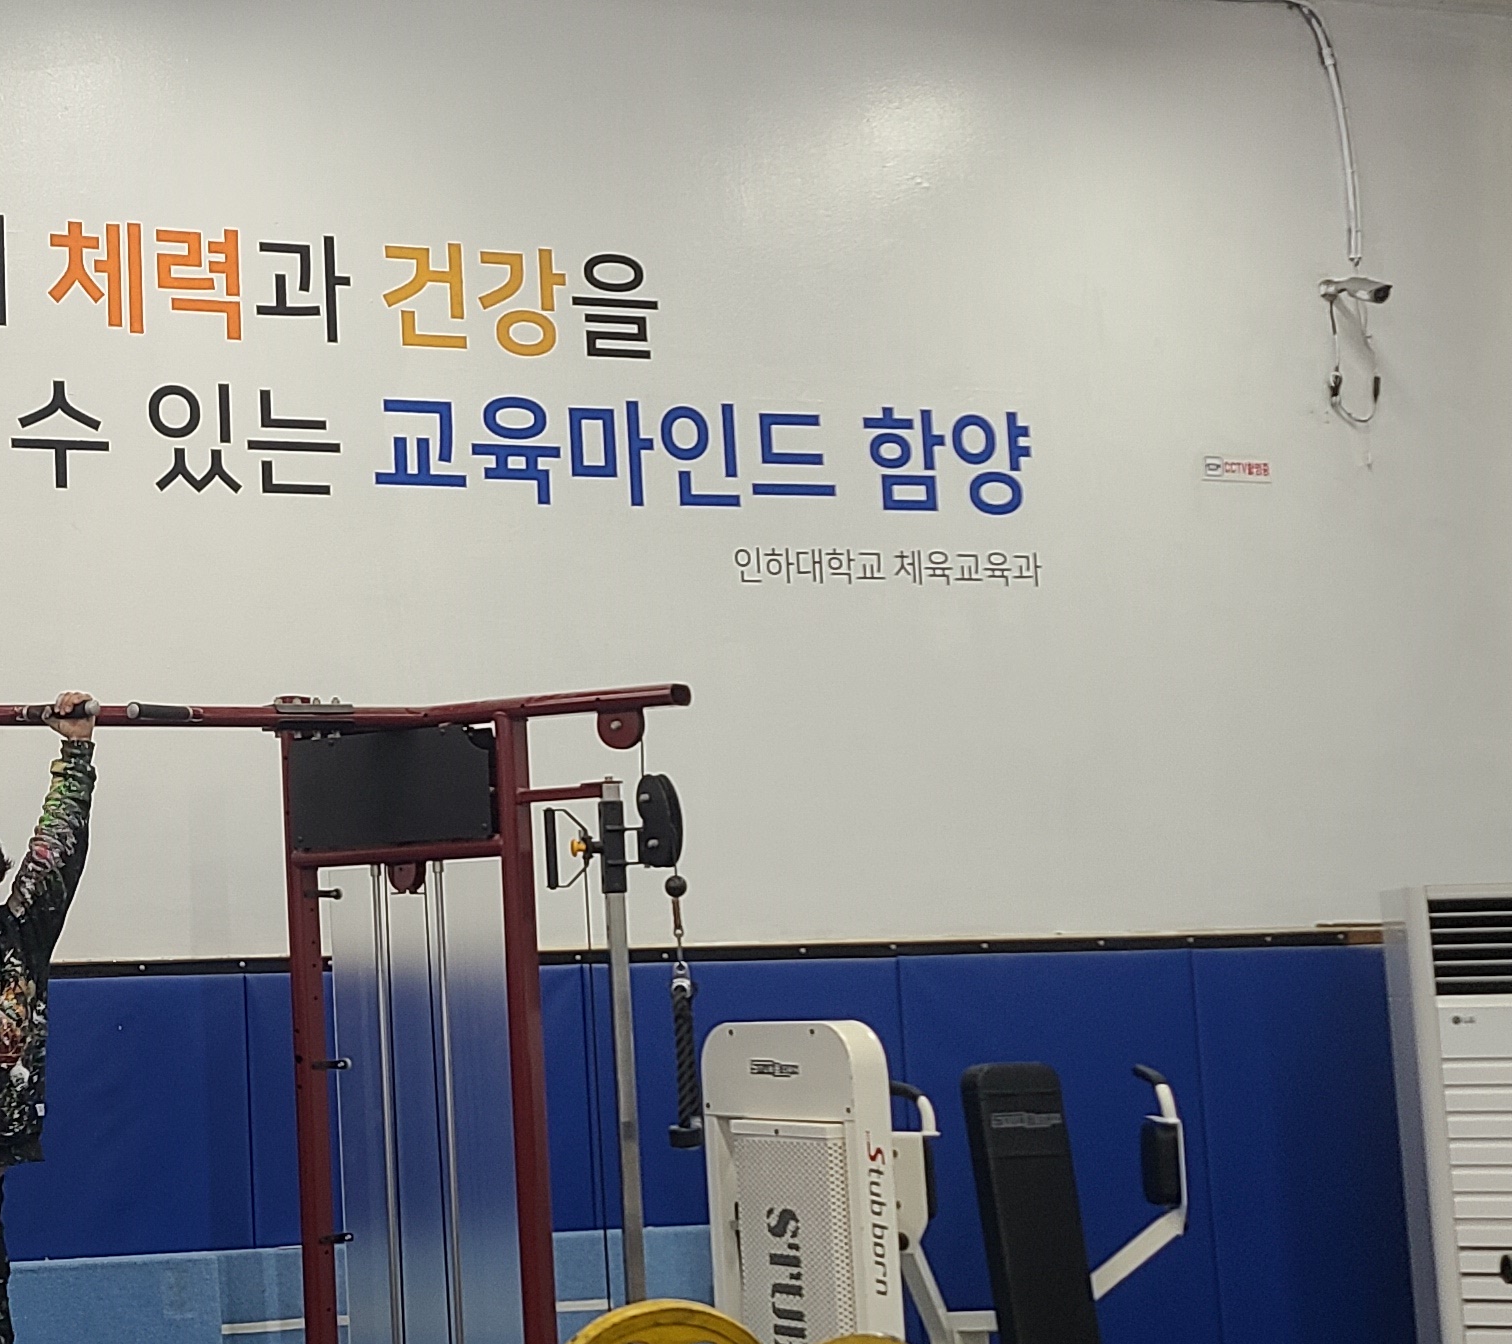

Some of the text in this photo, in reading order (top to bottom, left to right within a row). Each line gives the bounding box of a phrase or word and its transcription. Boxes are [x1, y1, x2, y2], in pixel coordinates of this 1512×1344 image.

[48, 220, 351, 344] 체력과
[382, 242, 659, 360] 건강을
[10, 379, 110, 489] 수
[147, 382, 342, 495] 있는
[374, 395, 836, 508] 교육마인드
[862, 405, 1033, 516] 함양
[733, 546, 1043, 588] 인하대학교 체육교육과
[865, 1131, 889, 1297] Stubborn
